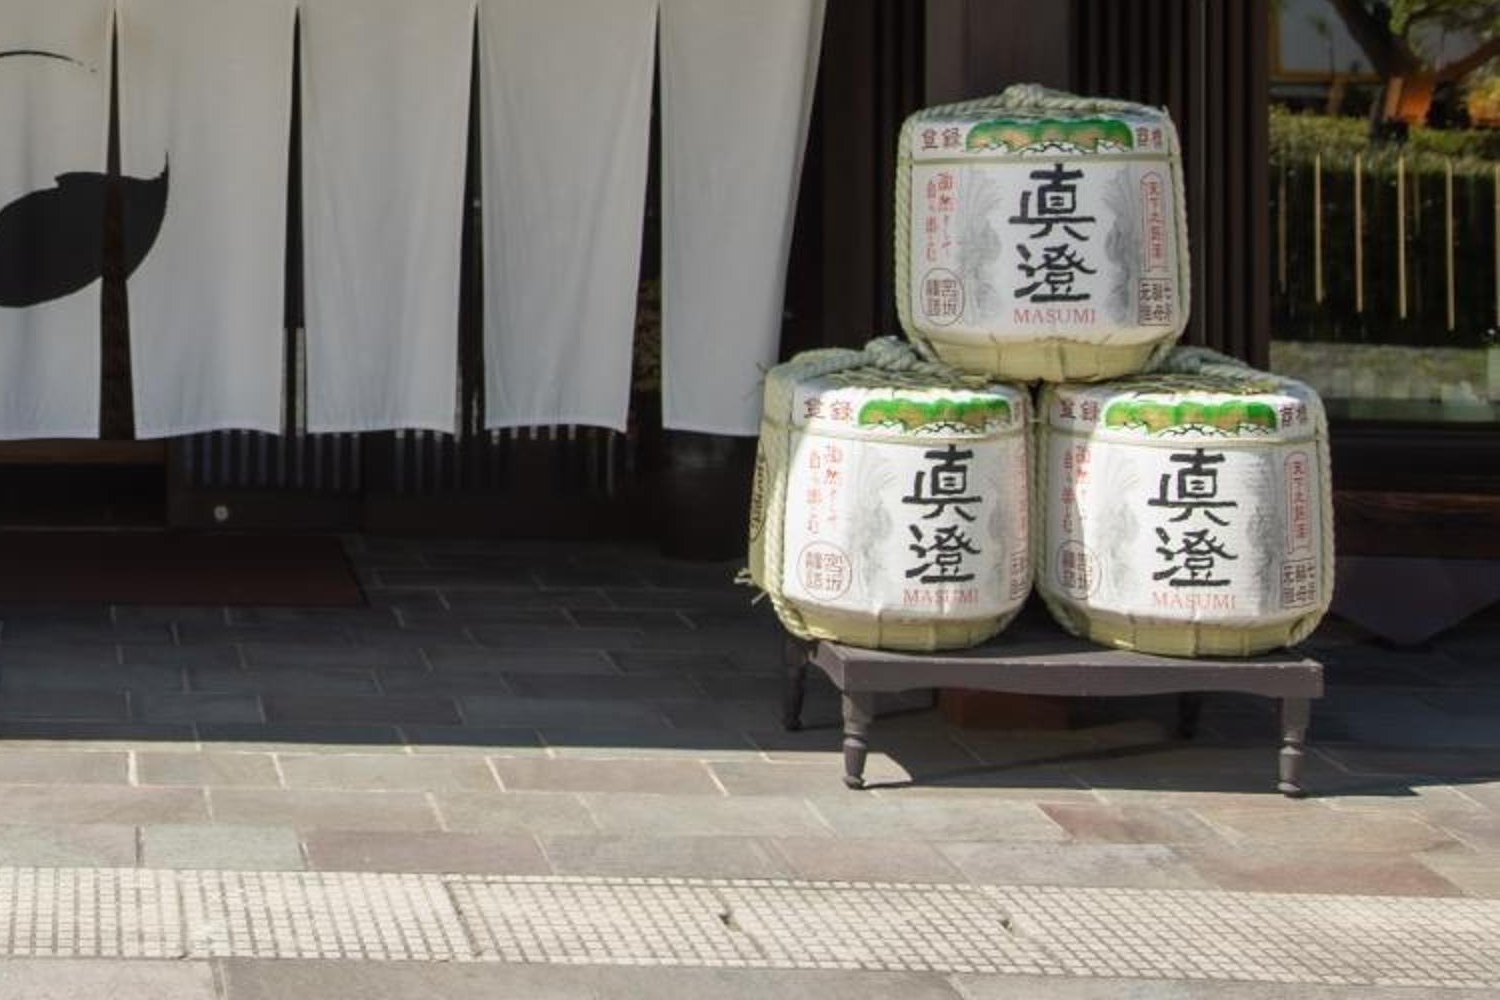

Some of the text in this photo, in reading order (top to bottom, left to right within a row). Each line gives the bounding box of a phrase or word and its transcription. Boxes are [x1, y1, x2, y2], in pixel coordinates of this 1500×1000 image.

[921, 127, 963, 149] 登録
[1013, 308, 1096, 325] MASUMI
[903, 588, 980, 605] MASUMI
[1153, 592, 1236, 611] MASUMI
